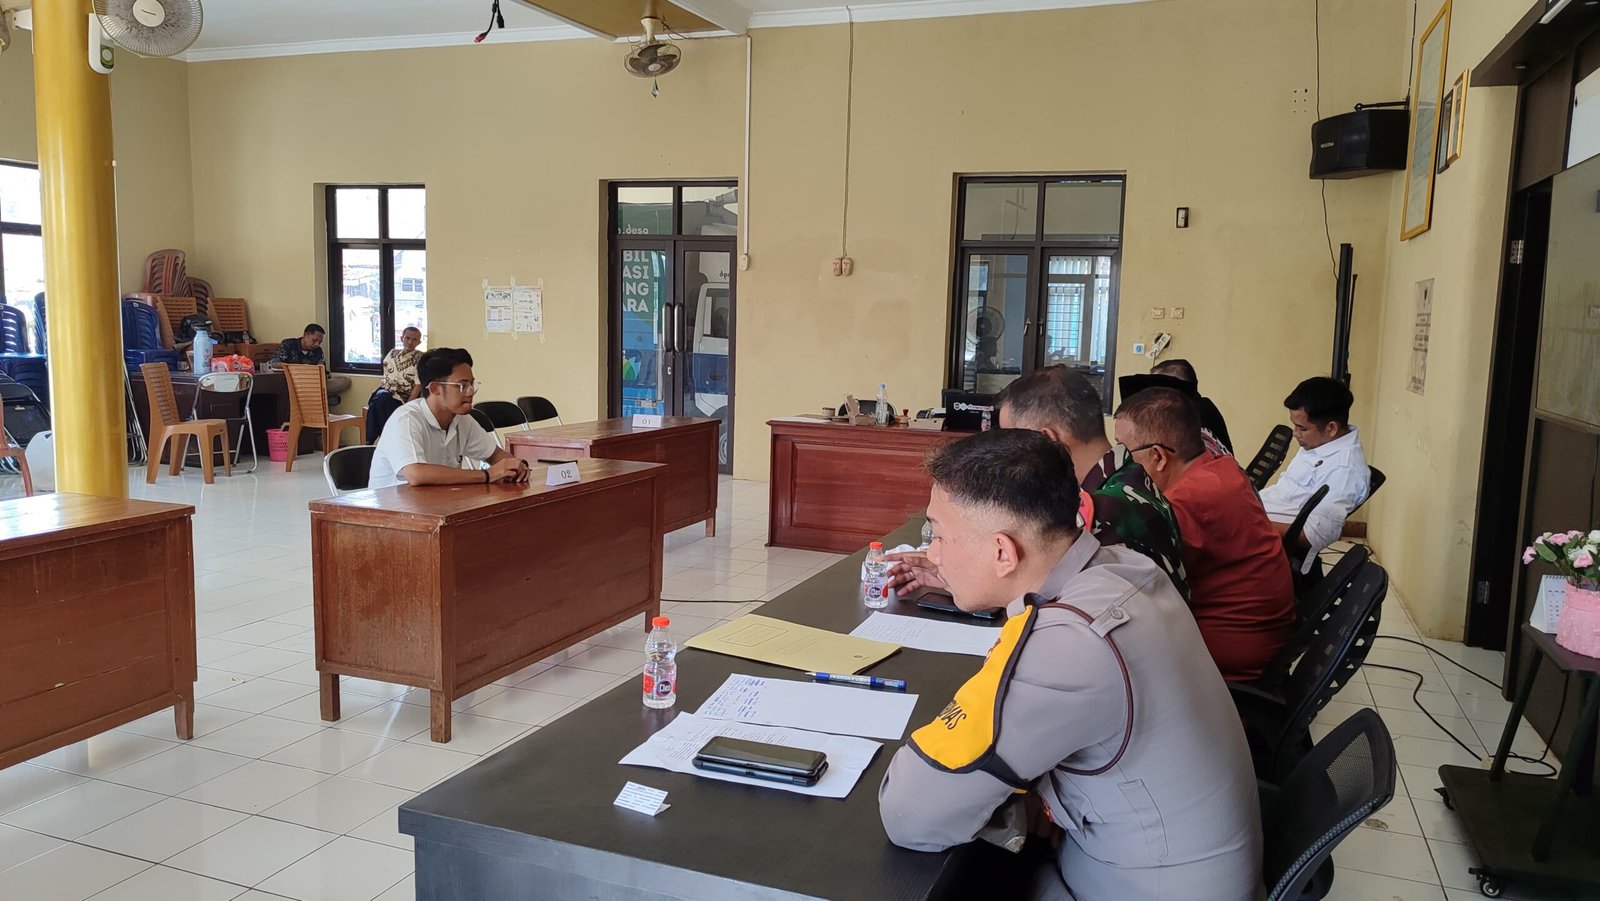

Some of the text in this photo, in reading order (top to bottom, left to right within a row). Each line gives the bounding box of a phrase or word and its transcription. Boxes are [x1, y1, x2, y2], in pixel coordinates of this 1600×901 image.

[623, 250, 649, 262] BIL
[623, 265, 649, 279] ASI
[719, 269, 730, 280] dp
[560, 469, 572, 480] 02
